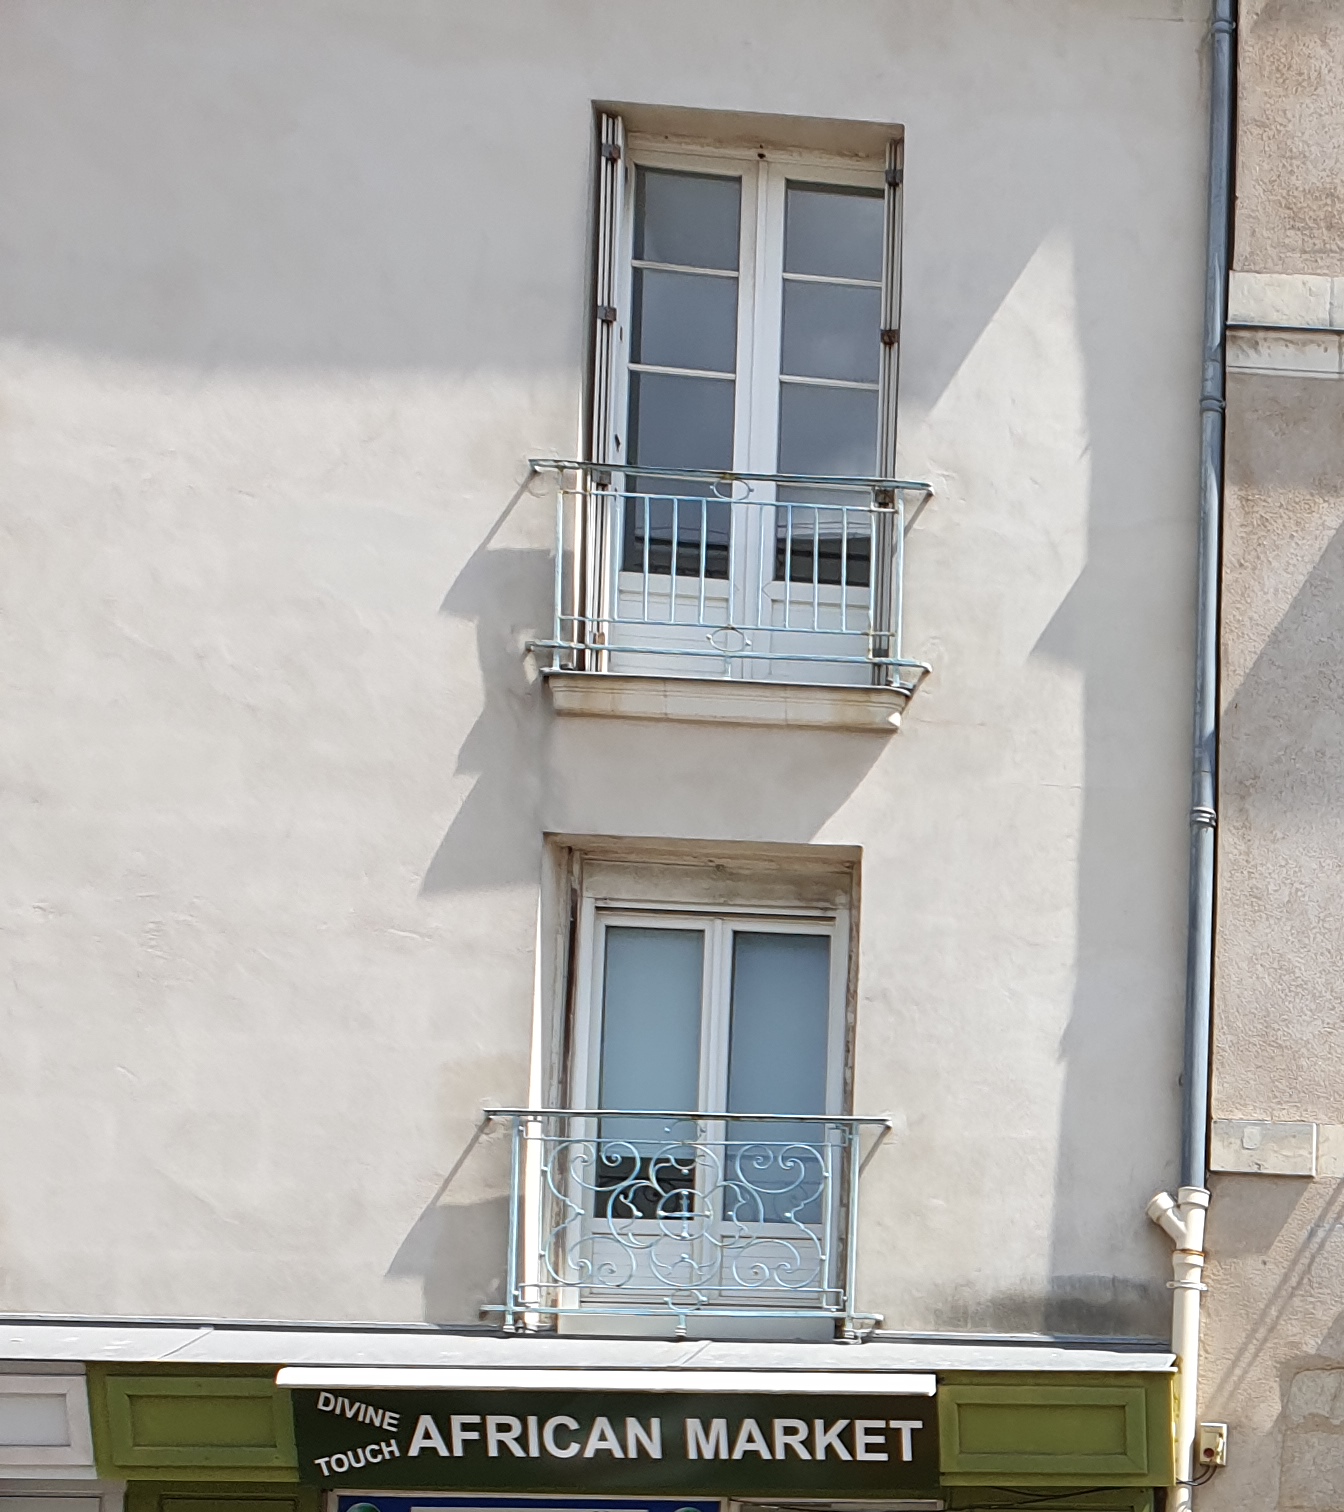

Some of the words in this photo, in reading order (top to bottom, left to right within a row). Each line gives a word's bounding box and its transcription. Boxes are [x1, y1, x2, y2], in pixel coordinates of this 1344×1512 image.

[316, 1391, 400, 1431] DIVINE
[314, 1438, 400, 1477] TOUCH
[407, 1414, 663, 1459] AFRICAN
[684, 1416, 923, 1462] MARKET
